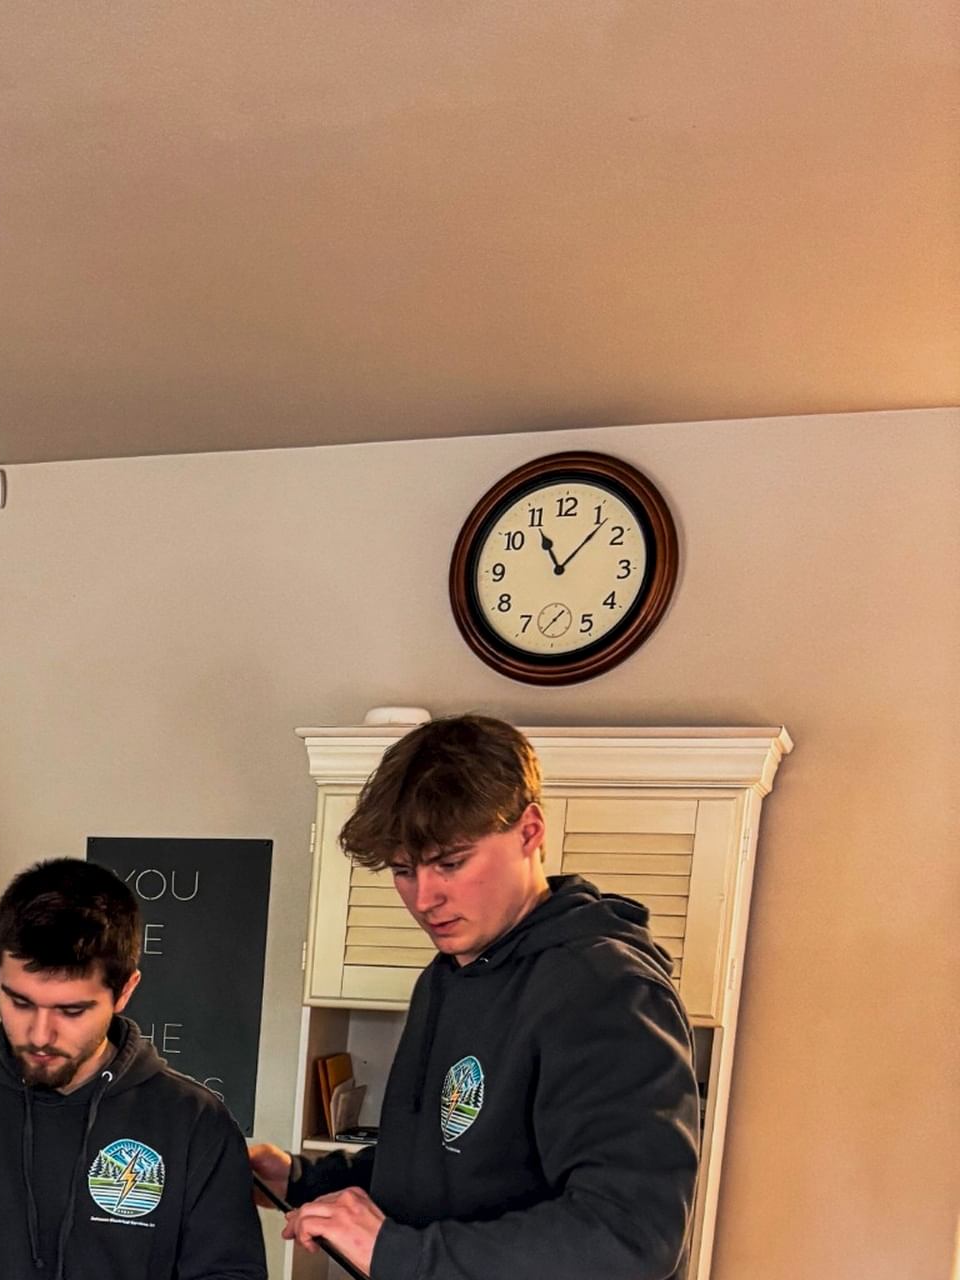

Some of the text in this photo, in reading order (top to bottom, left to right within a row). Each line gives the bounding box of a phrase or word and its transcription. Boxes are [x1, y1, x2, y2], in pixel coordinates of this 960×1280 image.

[528, 507, 544, 528] 11
[555, 497, 578, 518] 12
[593, 505, 603, 525] 1
[504, 531, 525, 551] 10
[609, 526, 625, 546] 2
[492, 563, 506, 582] 9
[616, 559, 631, 580] 3
[497, 593, 512, 613] 8
[602, 590, 617, 610] 4
[519, 614, 533, 633] 7
[579, 613, 594, 633] 5
[144, 923, 165, 955] E
